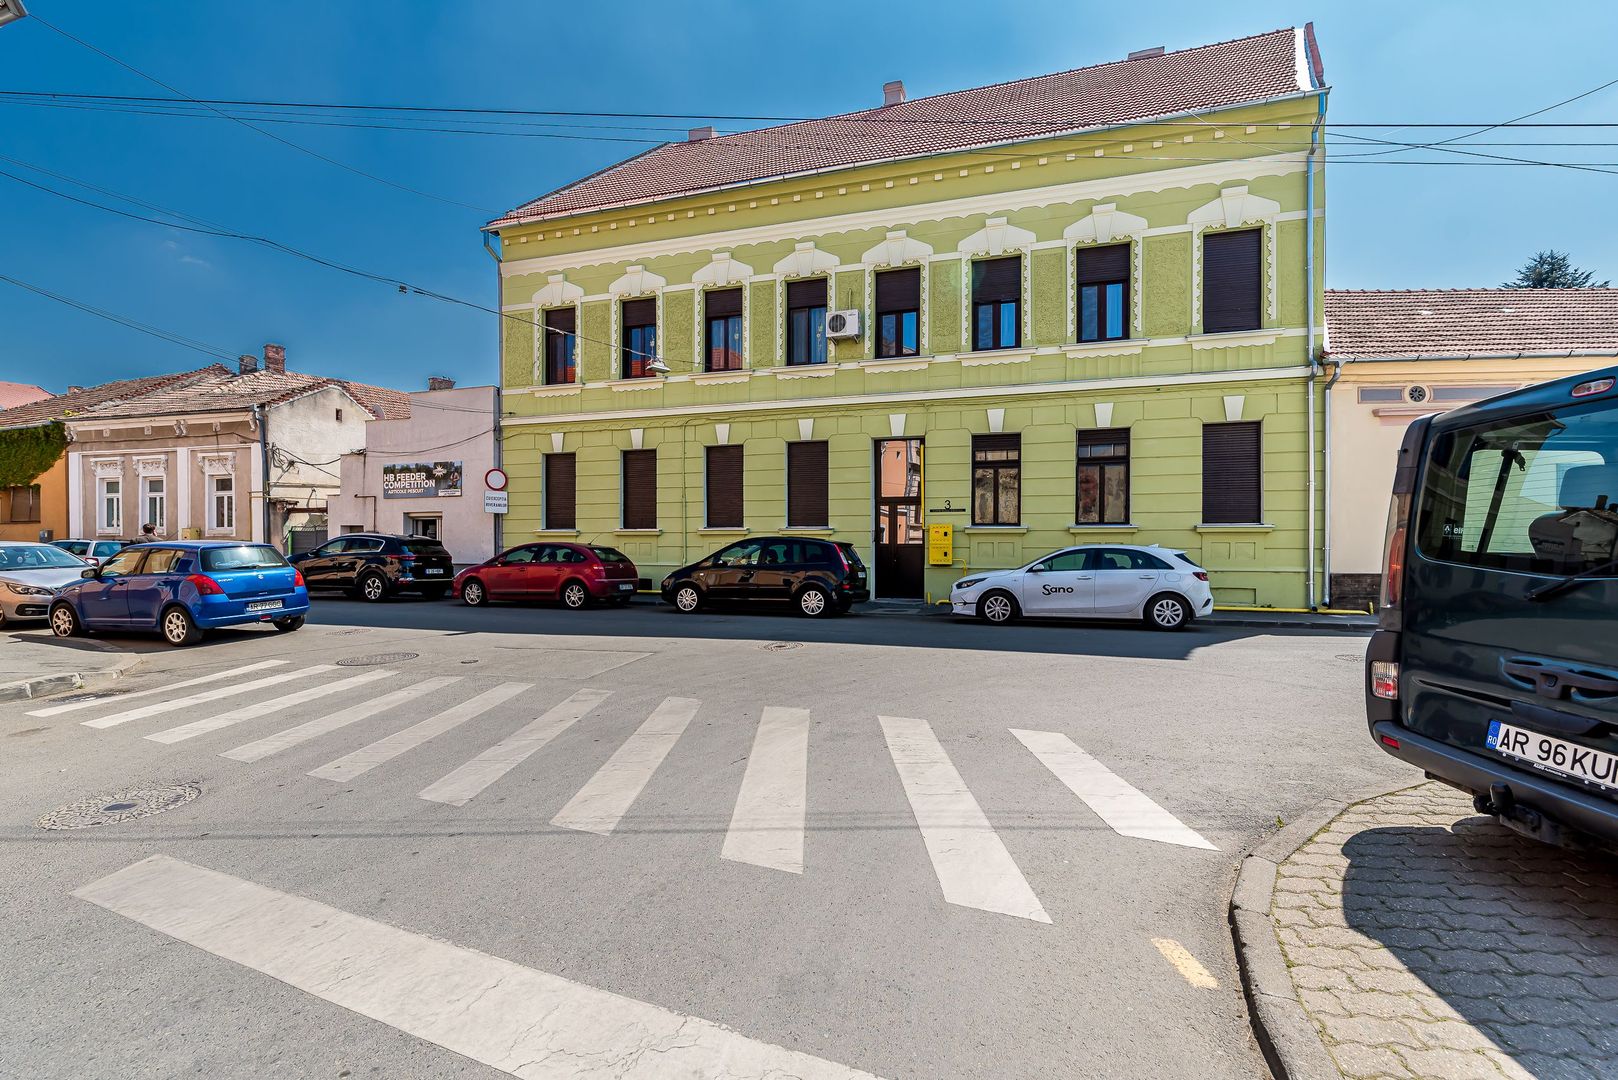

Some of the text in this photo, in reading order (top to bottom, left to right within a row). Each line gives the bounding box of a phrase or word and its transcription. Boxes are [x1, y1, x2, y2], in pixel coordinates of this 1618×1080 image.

[384, 472, 426, 482] HB FEEDER
[383, 480, 436, 489] COMPETITION
[944, 499, 951, 509] 3
[1041, 584, 1074, 596] Sano
[1487, 735, 1498, 746] RO
[1499, 728, 1530, 756] AR
[1536, 739, 1568, 767] 96
